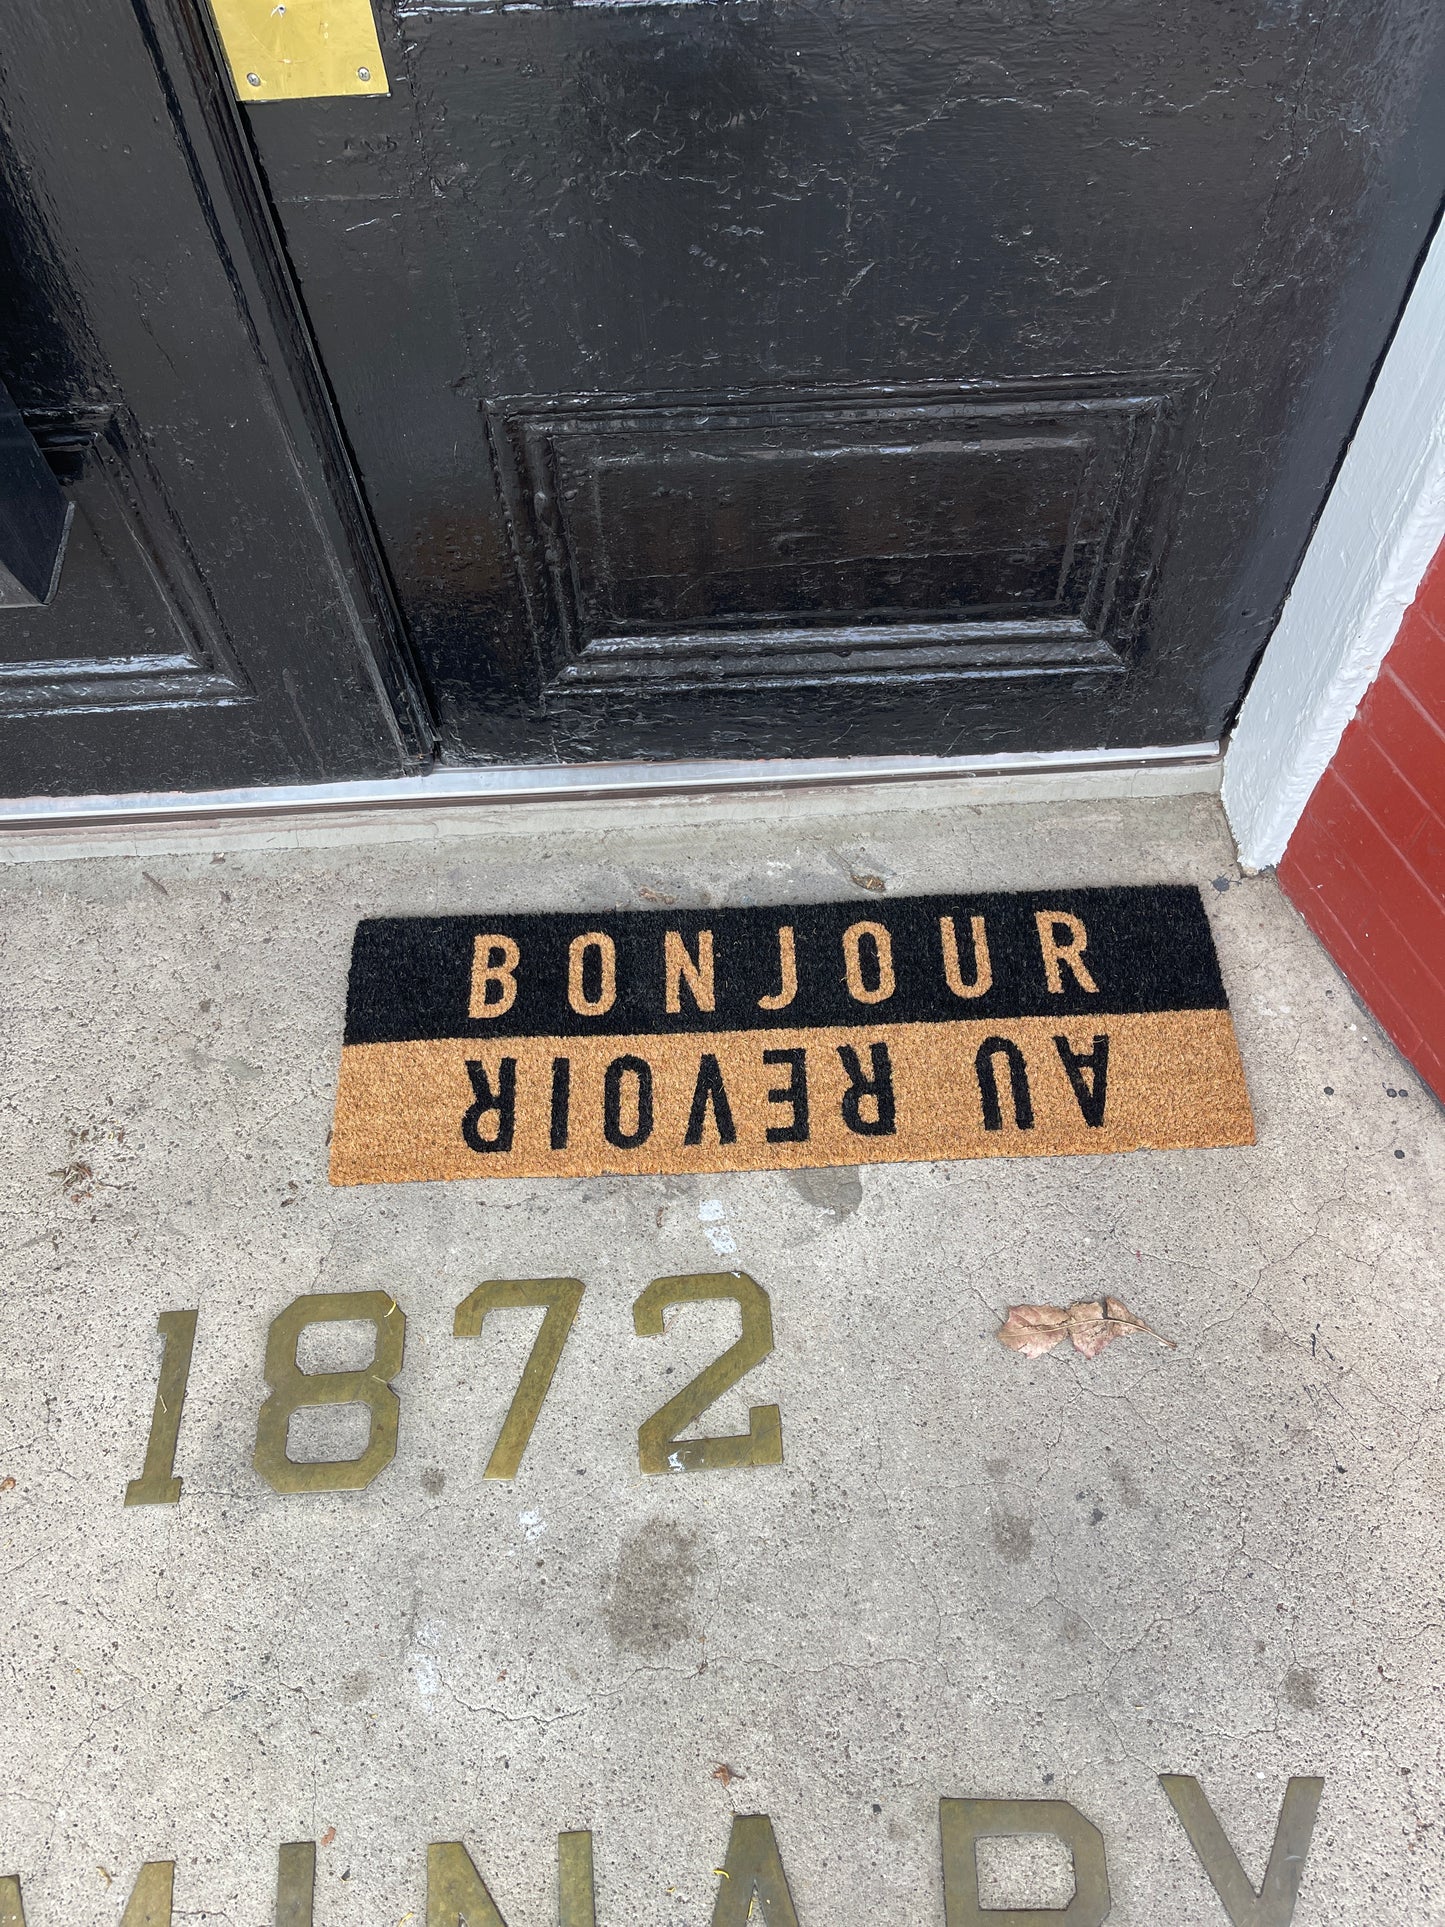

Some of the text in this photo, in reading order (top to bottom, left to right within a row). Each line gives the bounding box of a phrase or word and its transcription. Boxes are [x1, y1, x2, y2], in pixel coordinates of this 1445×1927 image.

[468, 909, 1099, 1019] BONJOUR
[461, 1034, 1109, 1153] AU REVOIR
[123, 1270, 784, 1508] 1872
